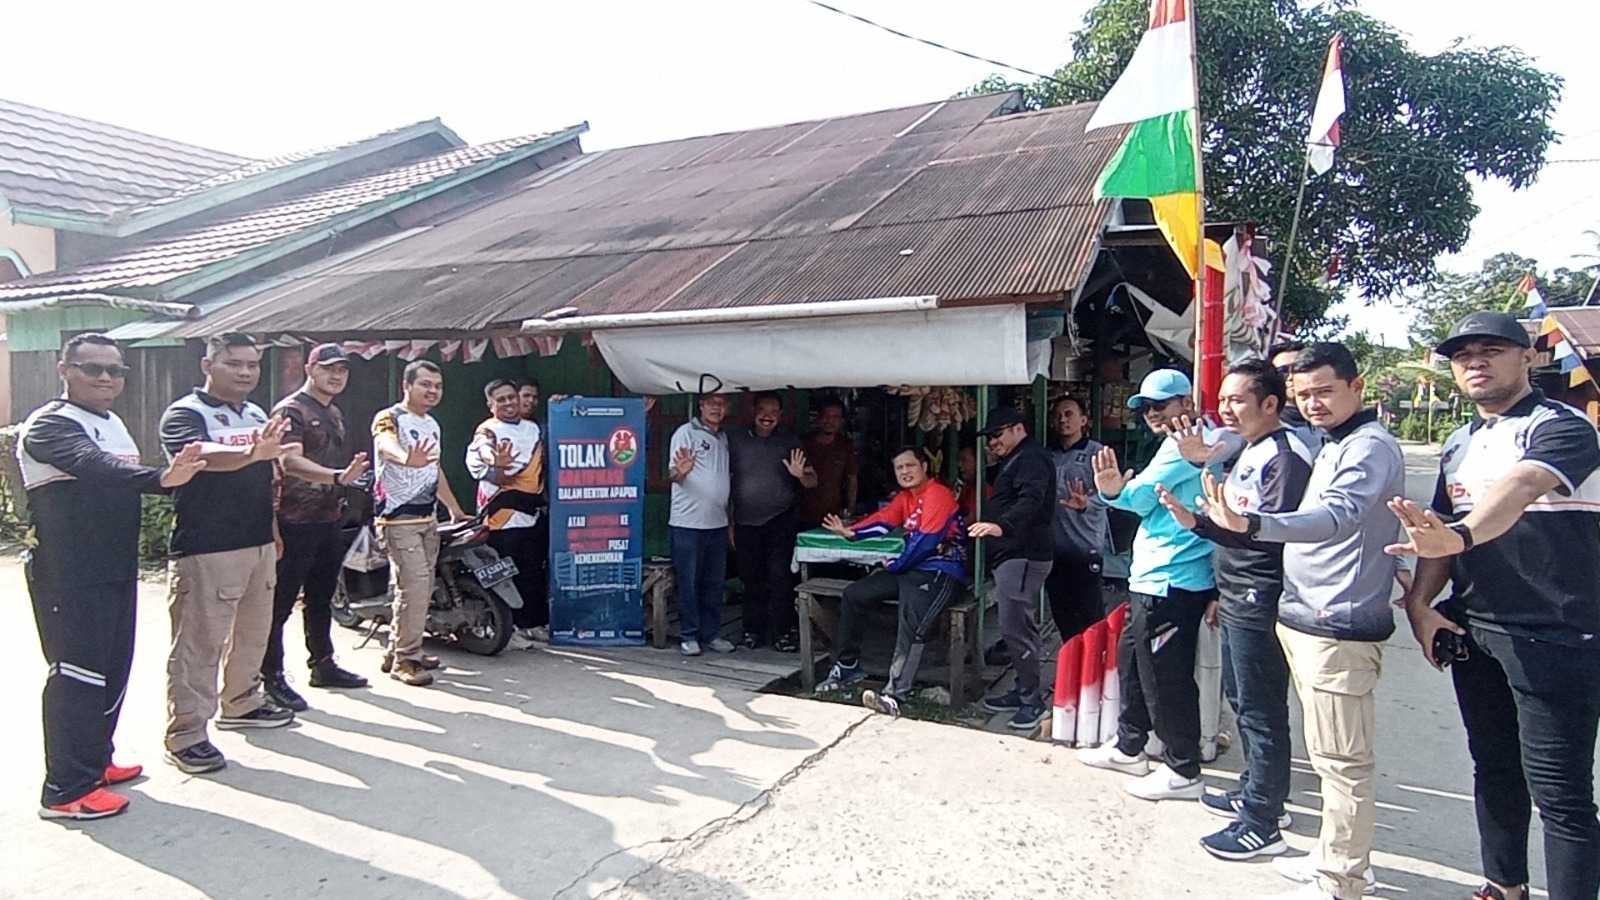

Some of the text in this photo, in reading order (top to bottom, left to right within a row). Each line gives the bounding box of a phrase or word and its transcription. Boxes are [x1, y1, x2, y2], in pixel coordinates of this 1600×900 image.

[558, 444, 606, 468] TOLAK
[558, 488, 582, 500] DALAM
[608, 539, 629, 551] PUSAT
